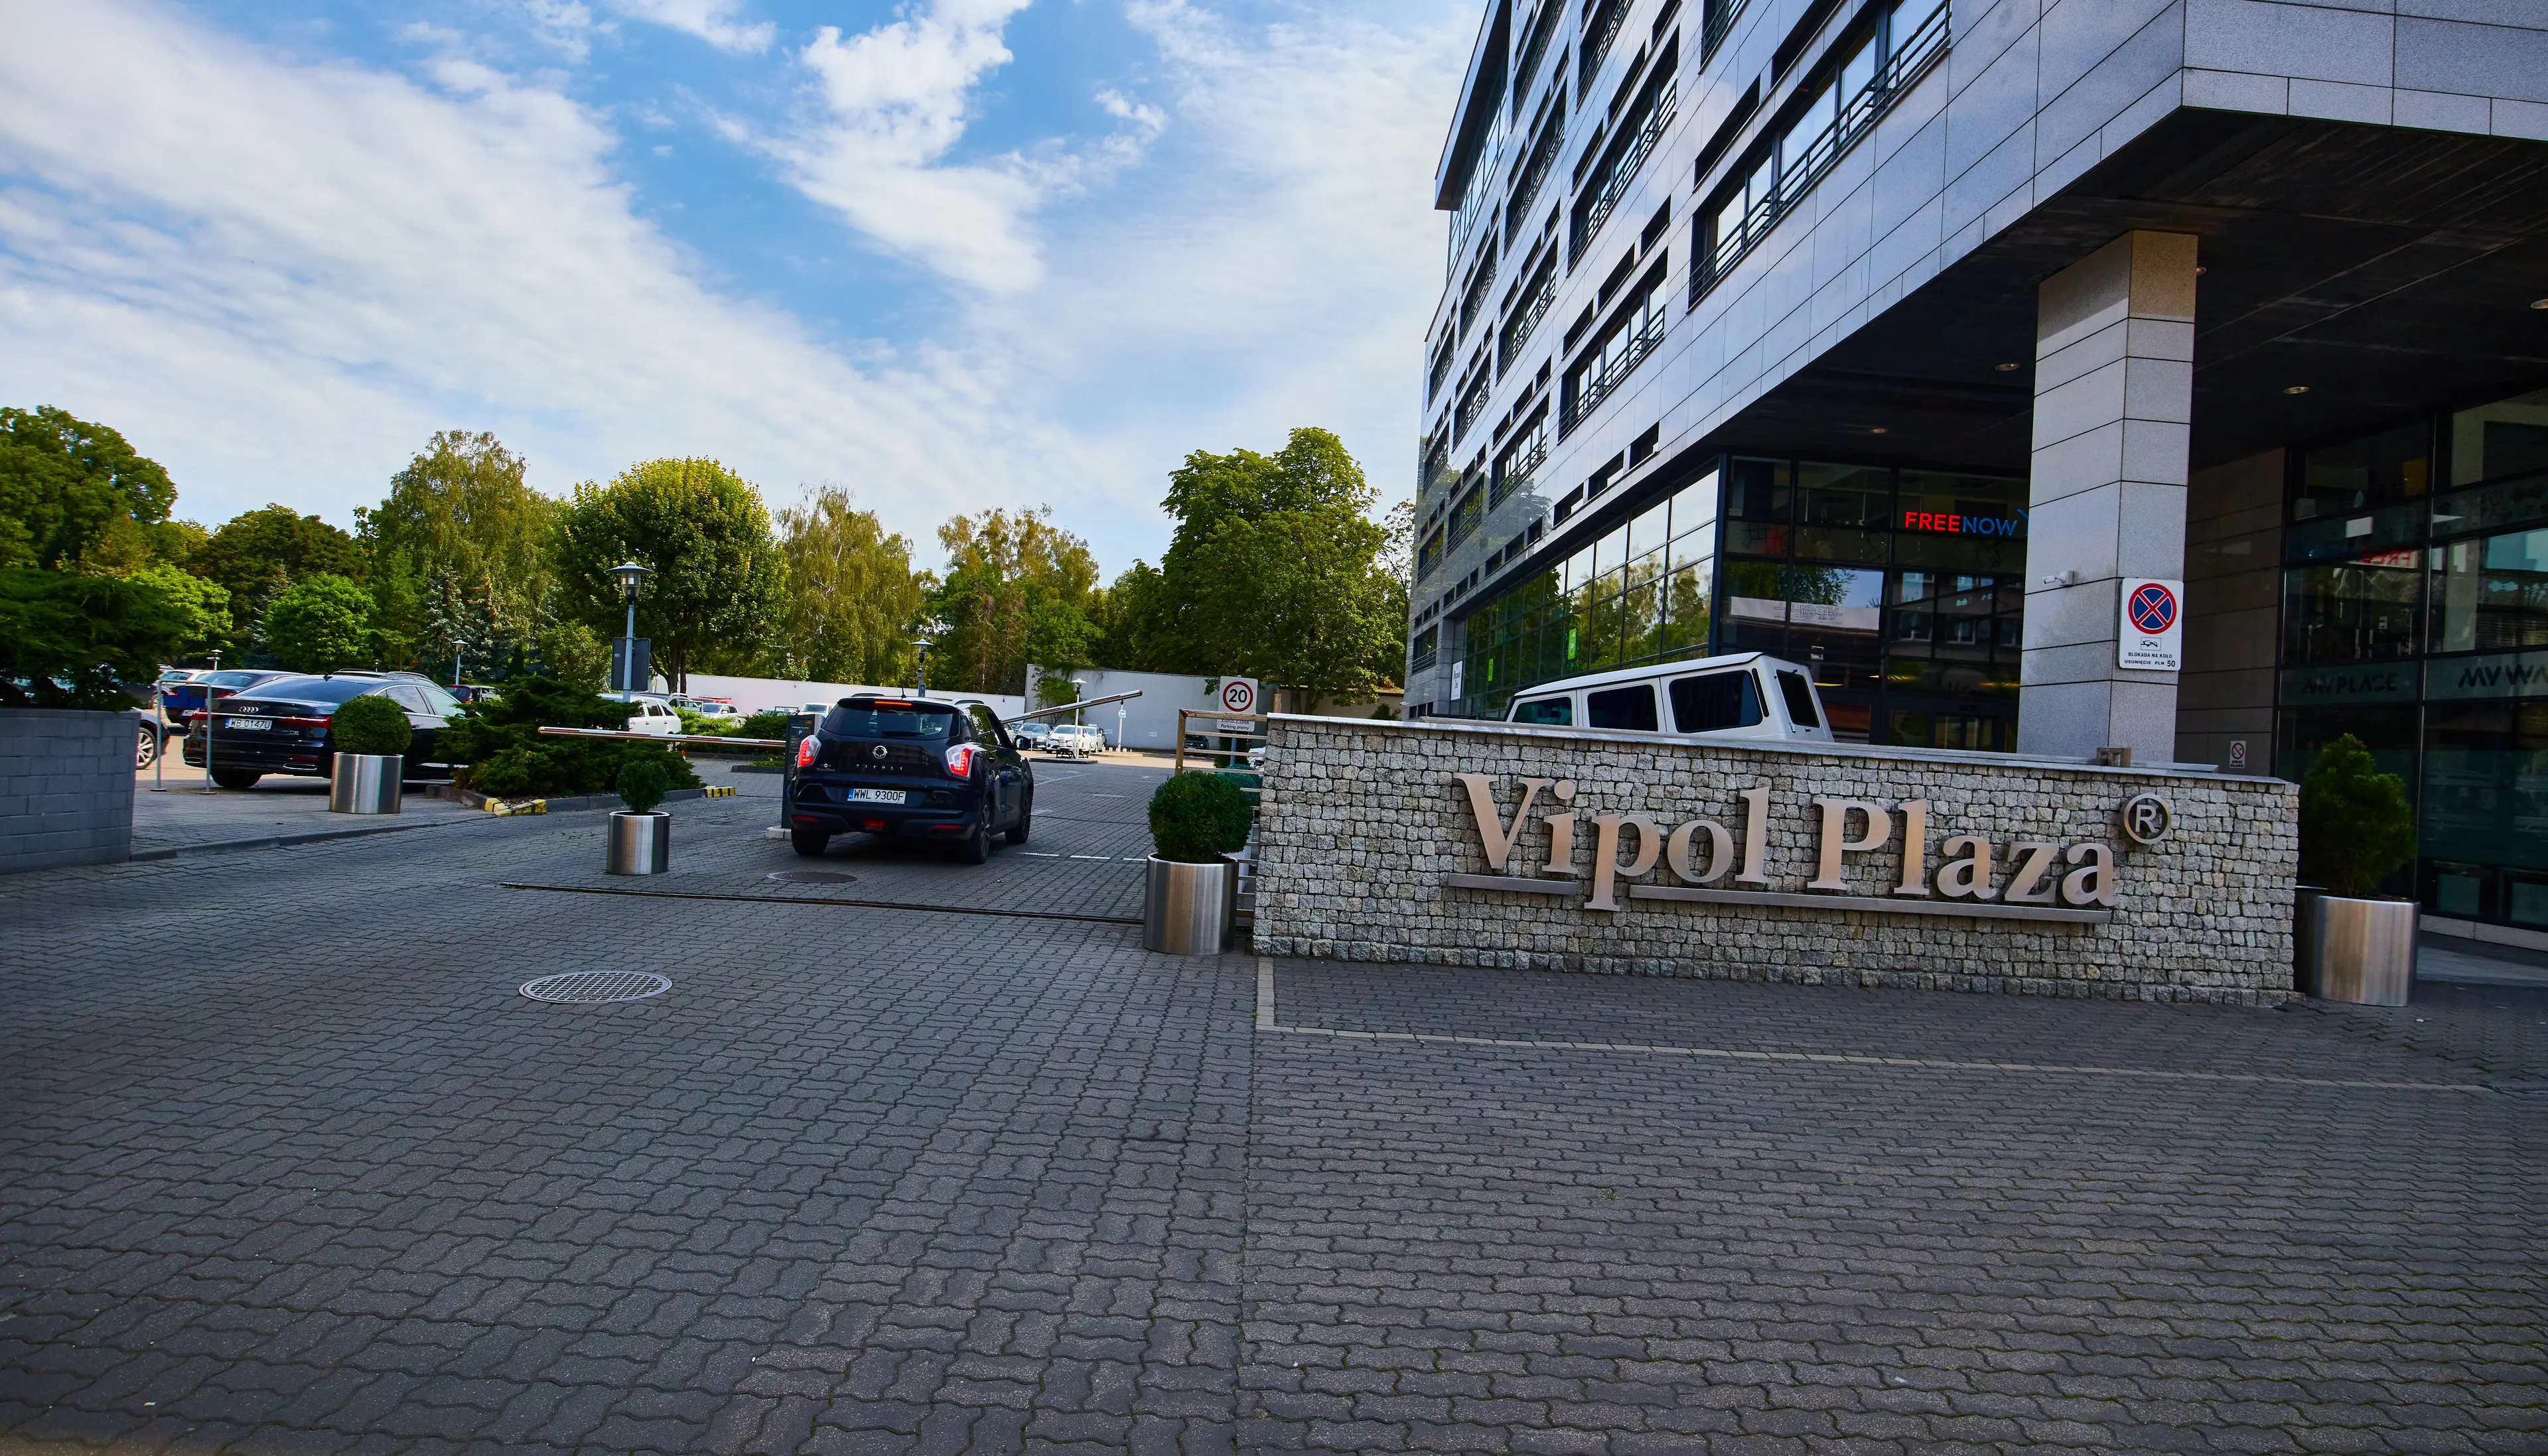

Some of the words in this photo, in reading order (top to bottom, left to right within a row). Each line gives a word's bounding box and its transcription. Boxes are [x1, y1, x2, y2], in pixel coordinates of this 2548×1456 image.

[1905, 511, 2017, 535] FREENOW
[1229, 689, 1247, 703] 20
[853, 789, 871, 800] WWL
[875, 790, 905, 801] 9300F
[1451, 773, 1770, 913] Vipol
[1806, 796, 2118, 907] Plaza
